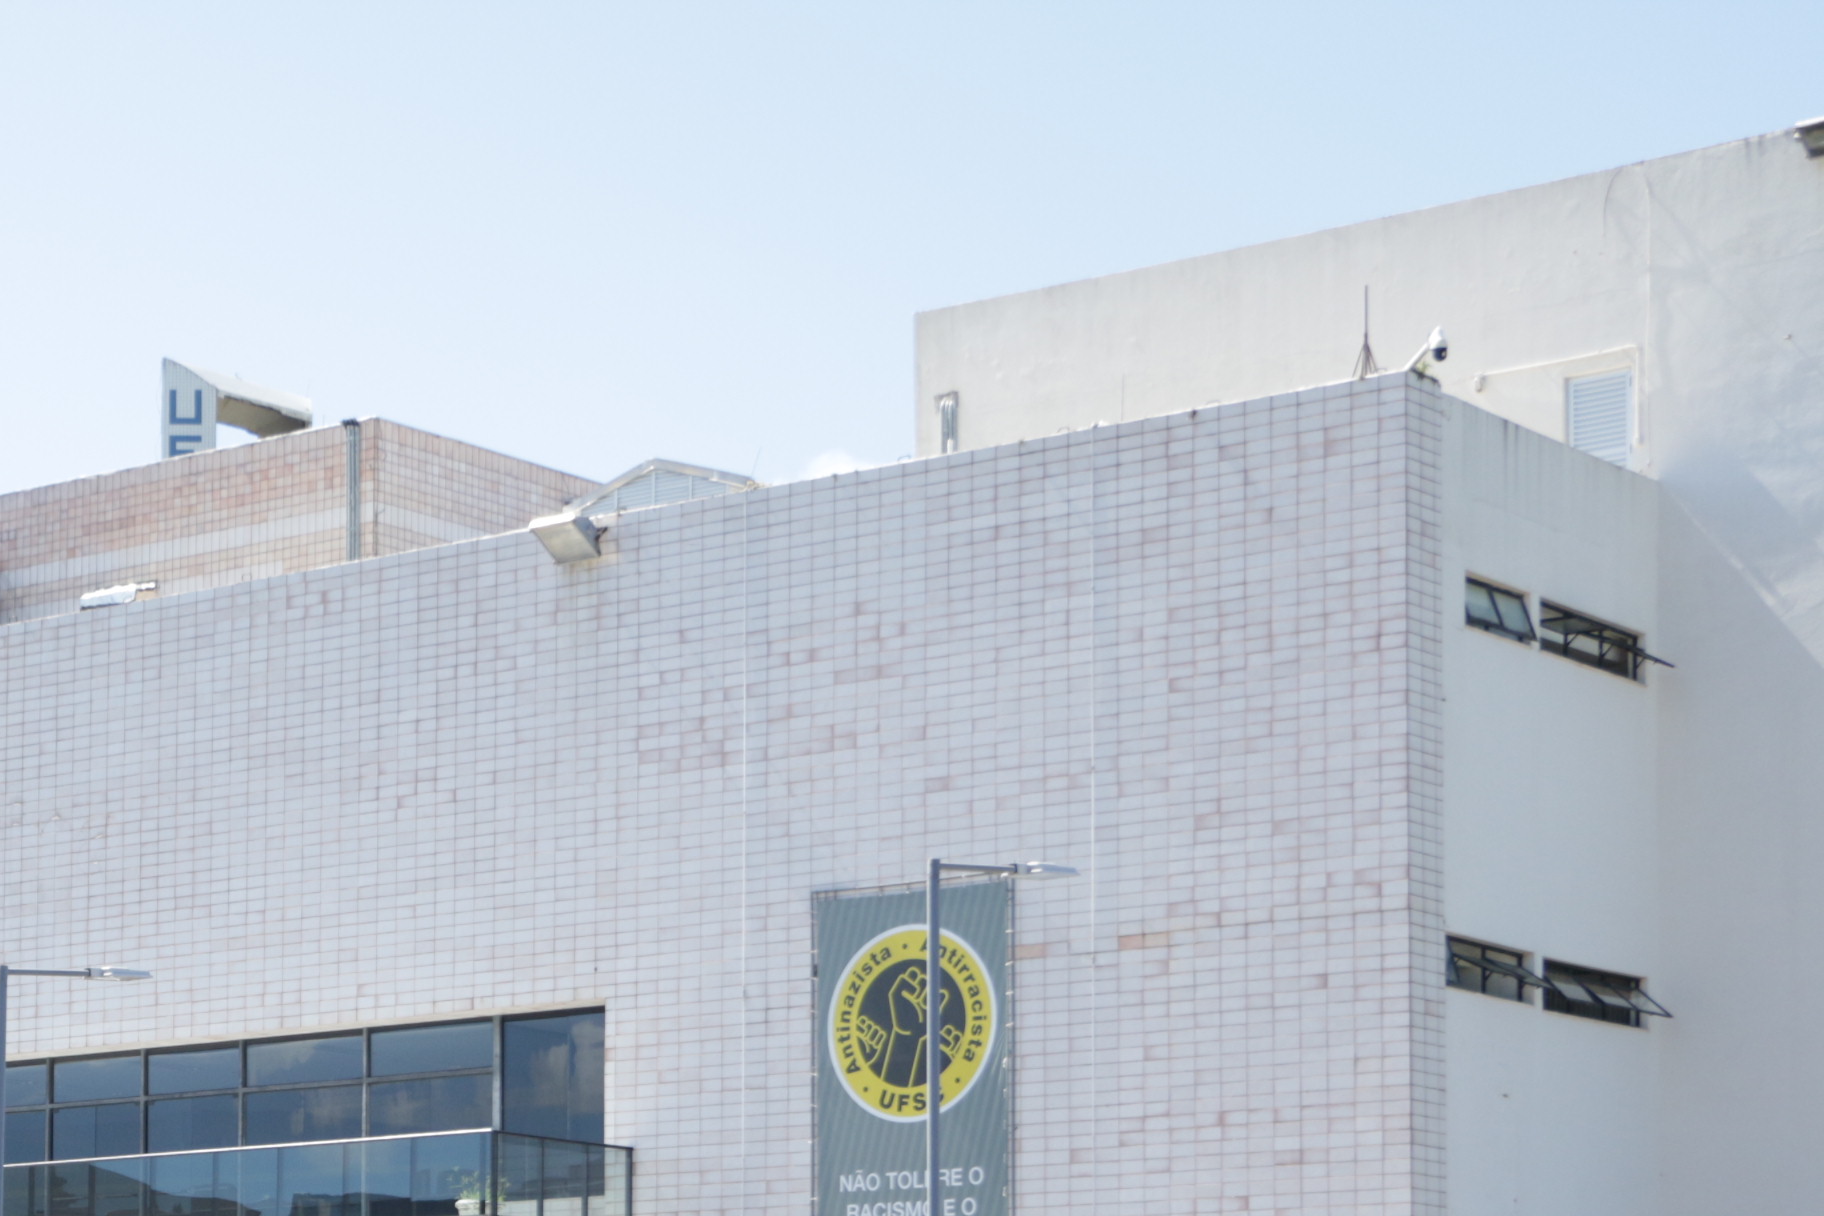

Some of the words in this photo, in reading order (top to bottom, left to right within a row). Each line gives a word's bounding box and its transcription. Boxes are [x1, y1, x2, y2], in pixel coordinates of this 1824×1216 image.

[836, 945, 892, 1075] Antinazista
[879, 1086, 944, 1113] UFS
[839, 1170, 880, 1192] NÃO
[885, 1168, 963, 1190] TOLRE
[968, 1166, 984, 1185] O
[943, 1199, 956, 1216] E
[961, 1197, 977, 1216] O
